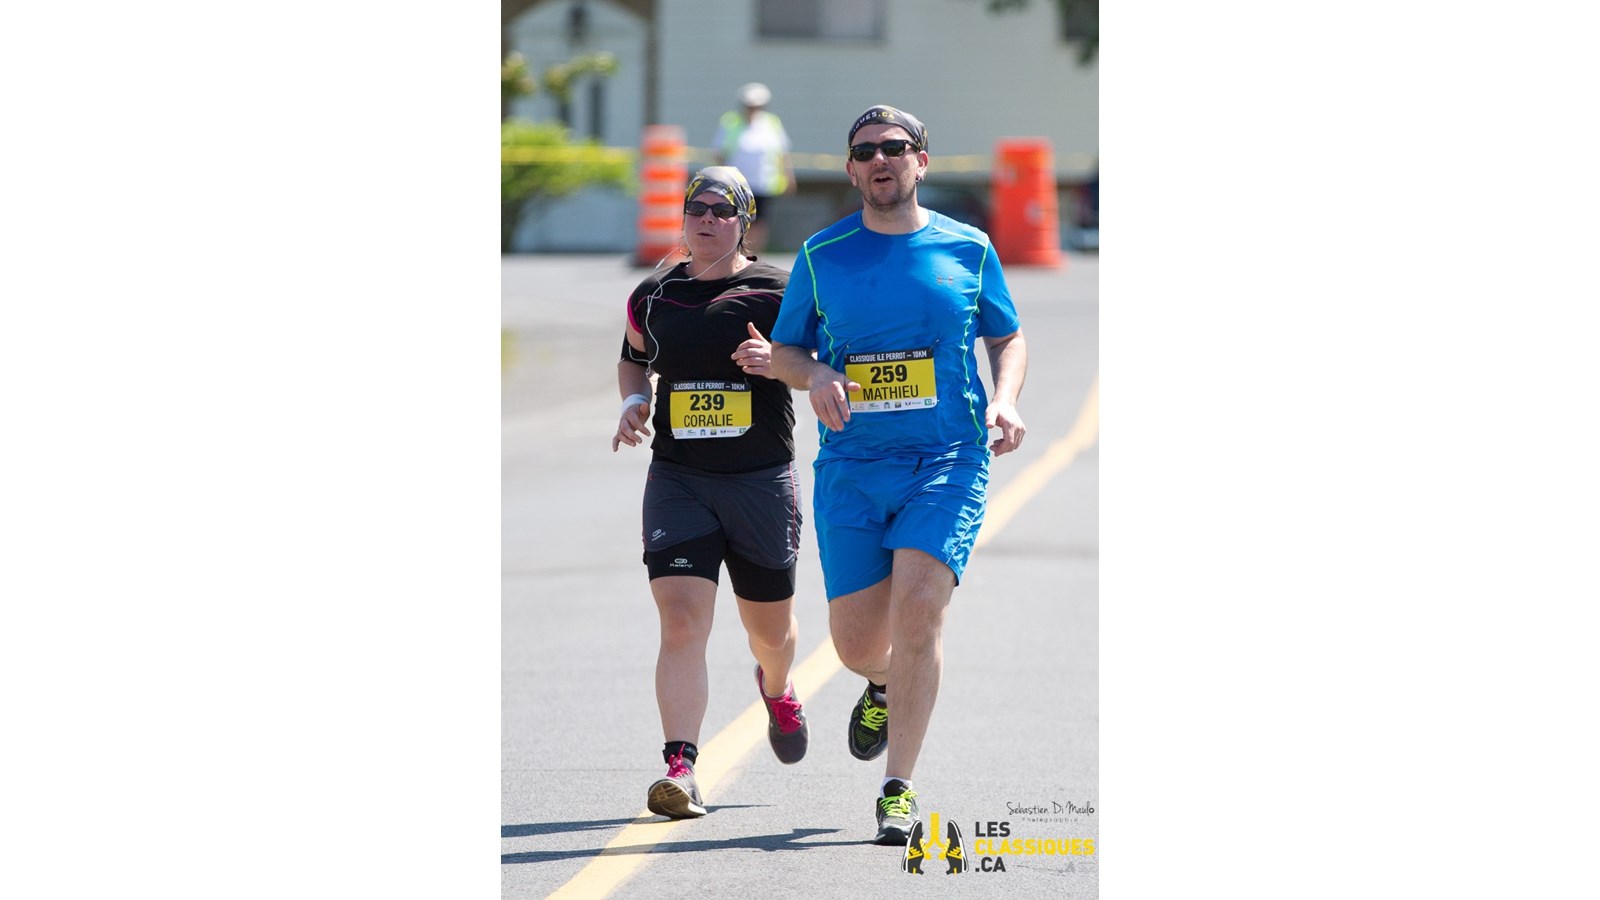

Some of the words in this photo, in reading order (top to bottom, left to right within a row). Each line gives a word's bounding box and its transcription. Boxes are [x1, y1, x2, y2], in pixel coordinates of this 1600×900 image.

[850, 354, 876, 363] CLASSIQUE
[876, 353, 885, 362] ILE
[885, 352, 906, 361] PERROT
[912, 350, 928, 359] 10KM
[870, 364, 908, 384] 259
[673, 382, 696, 391] CLASSIQUE
[696, 382, 705, 390] ILE
[705, 382, 725, 390] PERROT
[863, 384, 919, 401] MATHIEU
[689, 393, 725, 411] 239
[683, 414, 733, 427] CORALIE
